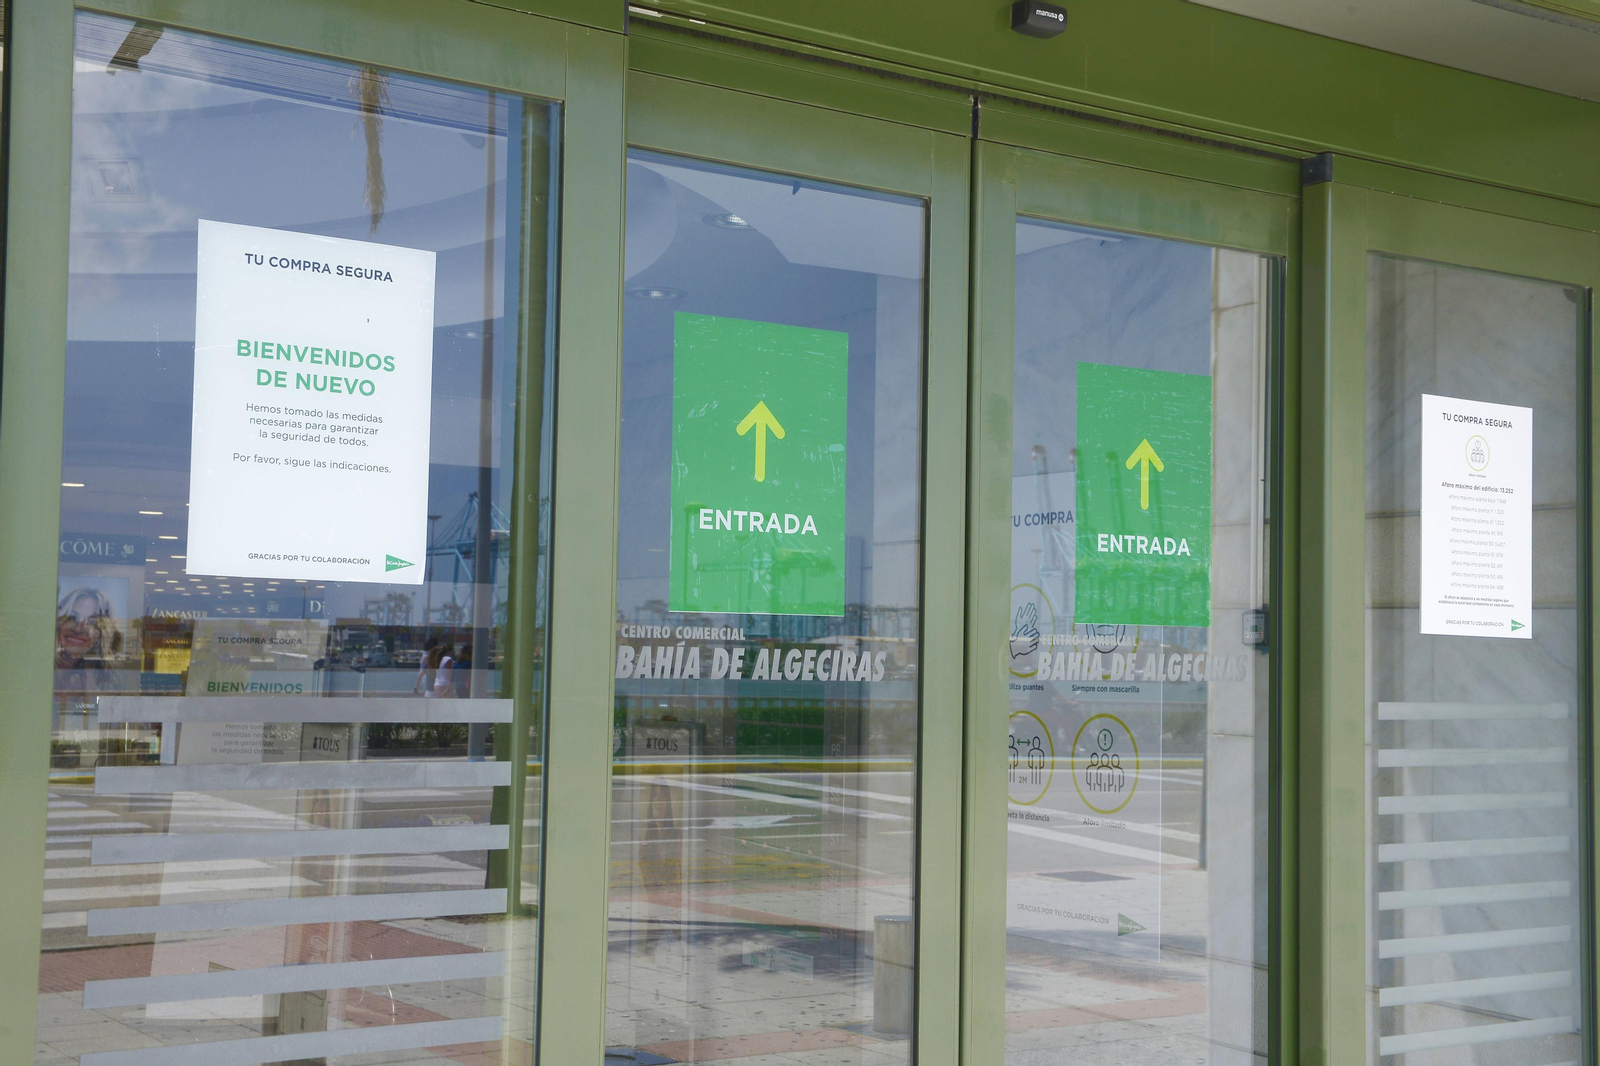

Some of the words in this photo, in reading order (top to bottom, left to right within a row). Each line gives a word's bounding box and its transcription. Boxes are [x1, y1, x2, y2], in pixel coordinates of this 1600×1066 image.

[244, 252, 264, 266] TU
[269, 256, 332, 275] COMPRA
[336, 264, 394, 283] SEGURA
[236, 338, 396, 373] BIENVENIDOS
[256, 368, 288, 389] DE
[295, 372, 376, 397] NUEVO
[246, 402, 282, 415] Hemos
[284, 406, 324, 418] tomado
[326, 409, 340, 420] las
[342, 411, 383, 424] medidas
[1442, 412, 1452, 421] TU
[1453, 414, 1484, 426] COMPRA
[1485, 418, 1513, 429] SEGURA
[249, 416, 302, 429] necesarias
[305, 421, 327, 432] para
[329, 422, 379, 436] garantizar
[259, 429, 268, 439] la
[270, 430, 321, 443] seguridad
[323, 434, 336, 444] de
[338, 436, 369, 447] todos.
[232, 452, 251, 462] Por
[253, 453, 281, 466] favor,
[284, 457, 311, 468] sigue
[313, 458, 327, 469] las
[329, 460, 392, 474] indicaciones.
[1441, 481, 1455, 489] Aforo
[1455, 483, 1473, 491] máximo
[1481, 485, 1499, 493] edificio:
[699, 507, 819, 536] ENTRADA
[1011, 514, 1021, 528] U
[1024, 510, 1074, 527] COMPRA
[1097, 533, 1191, 556] ENTRADA
[248, 552, 281, 562] GRACIAS
[283, 554, 299, 562] POR
[312, 555, 371, 565] COLABORACIÓN
[151, 608, 208, 620] LANCASTER
[621, 624, 672, 640] CENTRO
[675, 625, 746, 641] COMERCIAL
[217, 636, 229, 645] TU
[231, 636, 267, 645] COMPRA
[268, 637, 303, 646] SEGURA
[1041, 635, 1079, 646] CENTRO
[1081, 634, 1138, 647] COMERCIAL
[615, 641, 701, 680] BAHÍA
[710, 647, 746, 681] DE
[751, 648, 887, 683] ALGECIRAS
[1037, 648, 1100, 682] BAHÍA
[1110, 652, 1136, 682] DE
[1141, 653, 1248, 683] ALGECIRAS
[207, 681, 303, 694] BIENVENIDOS
[1022, 683, 1044, 692] guantes
[1071, 684, 1096, 694] Siempre
[1109, 685, 1140, 694] mascarilla
[250, 723, 276, 731] tomado
[223, 731, 251, 739] medidas
[219, 747, 252, 755] seguridad
[240, 740, 275, 748] garantizar
[318, 737, 340, 753] TOUS
[653, 737, 679, 752] TOUS
[1018, 776, 1028, 784] 2M
[1019, 812, 1024, 820] la
[1025, 813, 1050, 822] distancia
[1083, 818, 1100, 827] Aforo
[1101, 819, 1127, 830] limitado
[1016, 903, 1041, 914] GRACIAS
[1042, 907, 1053, 915] POR
[1054, 909, 1062, 917] TU
[1063, 911, 1110, 925] COLABORACIÓN
